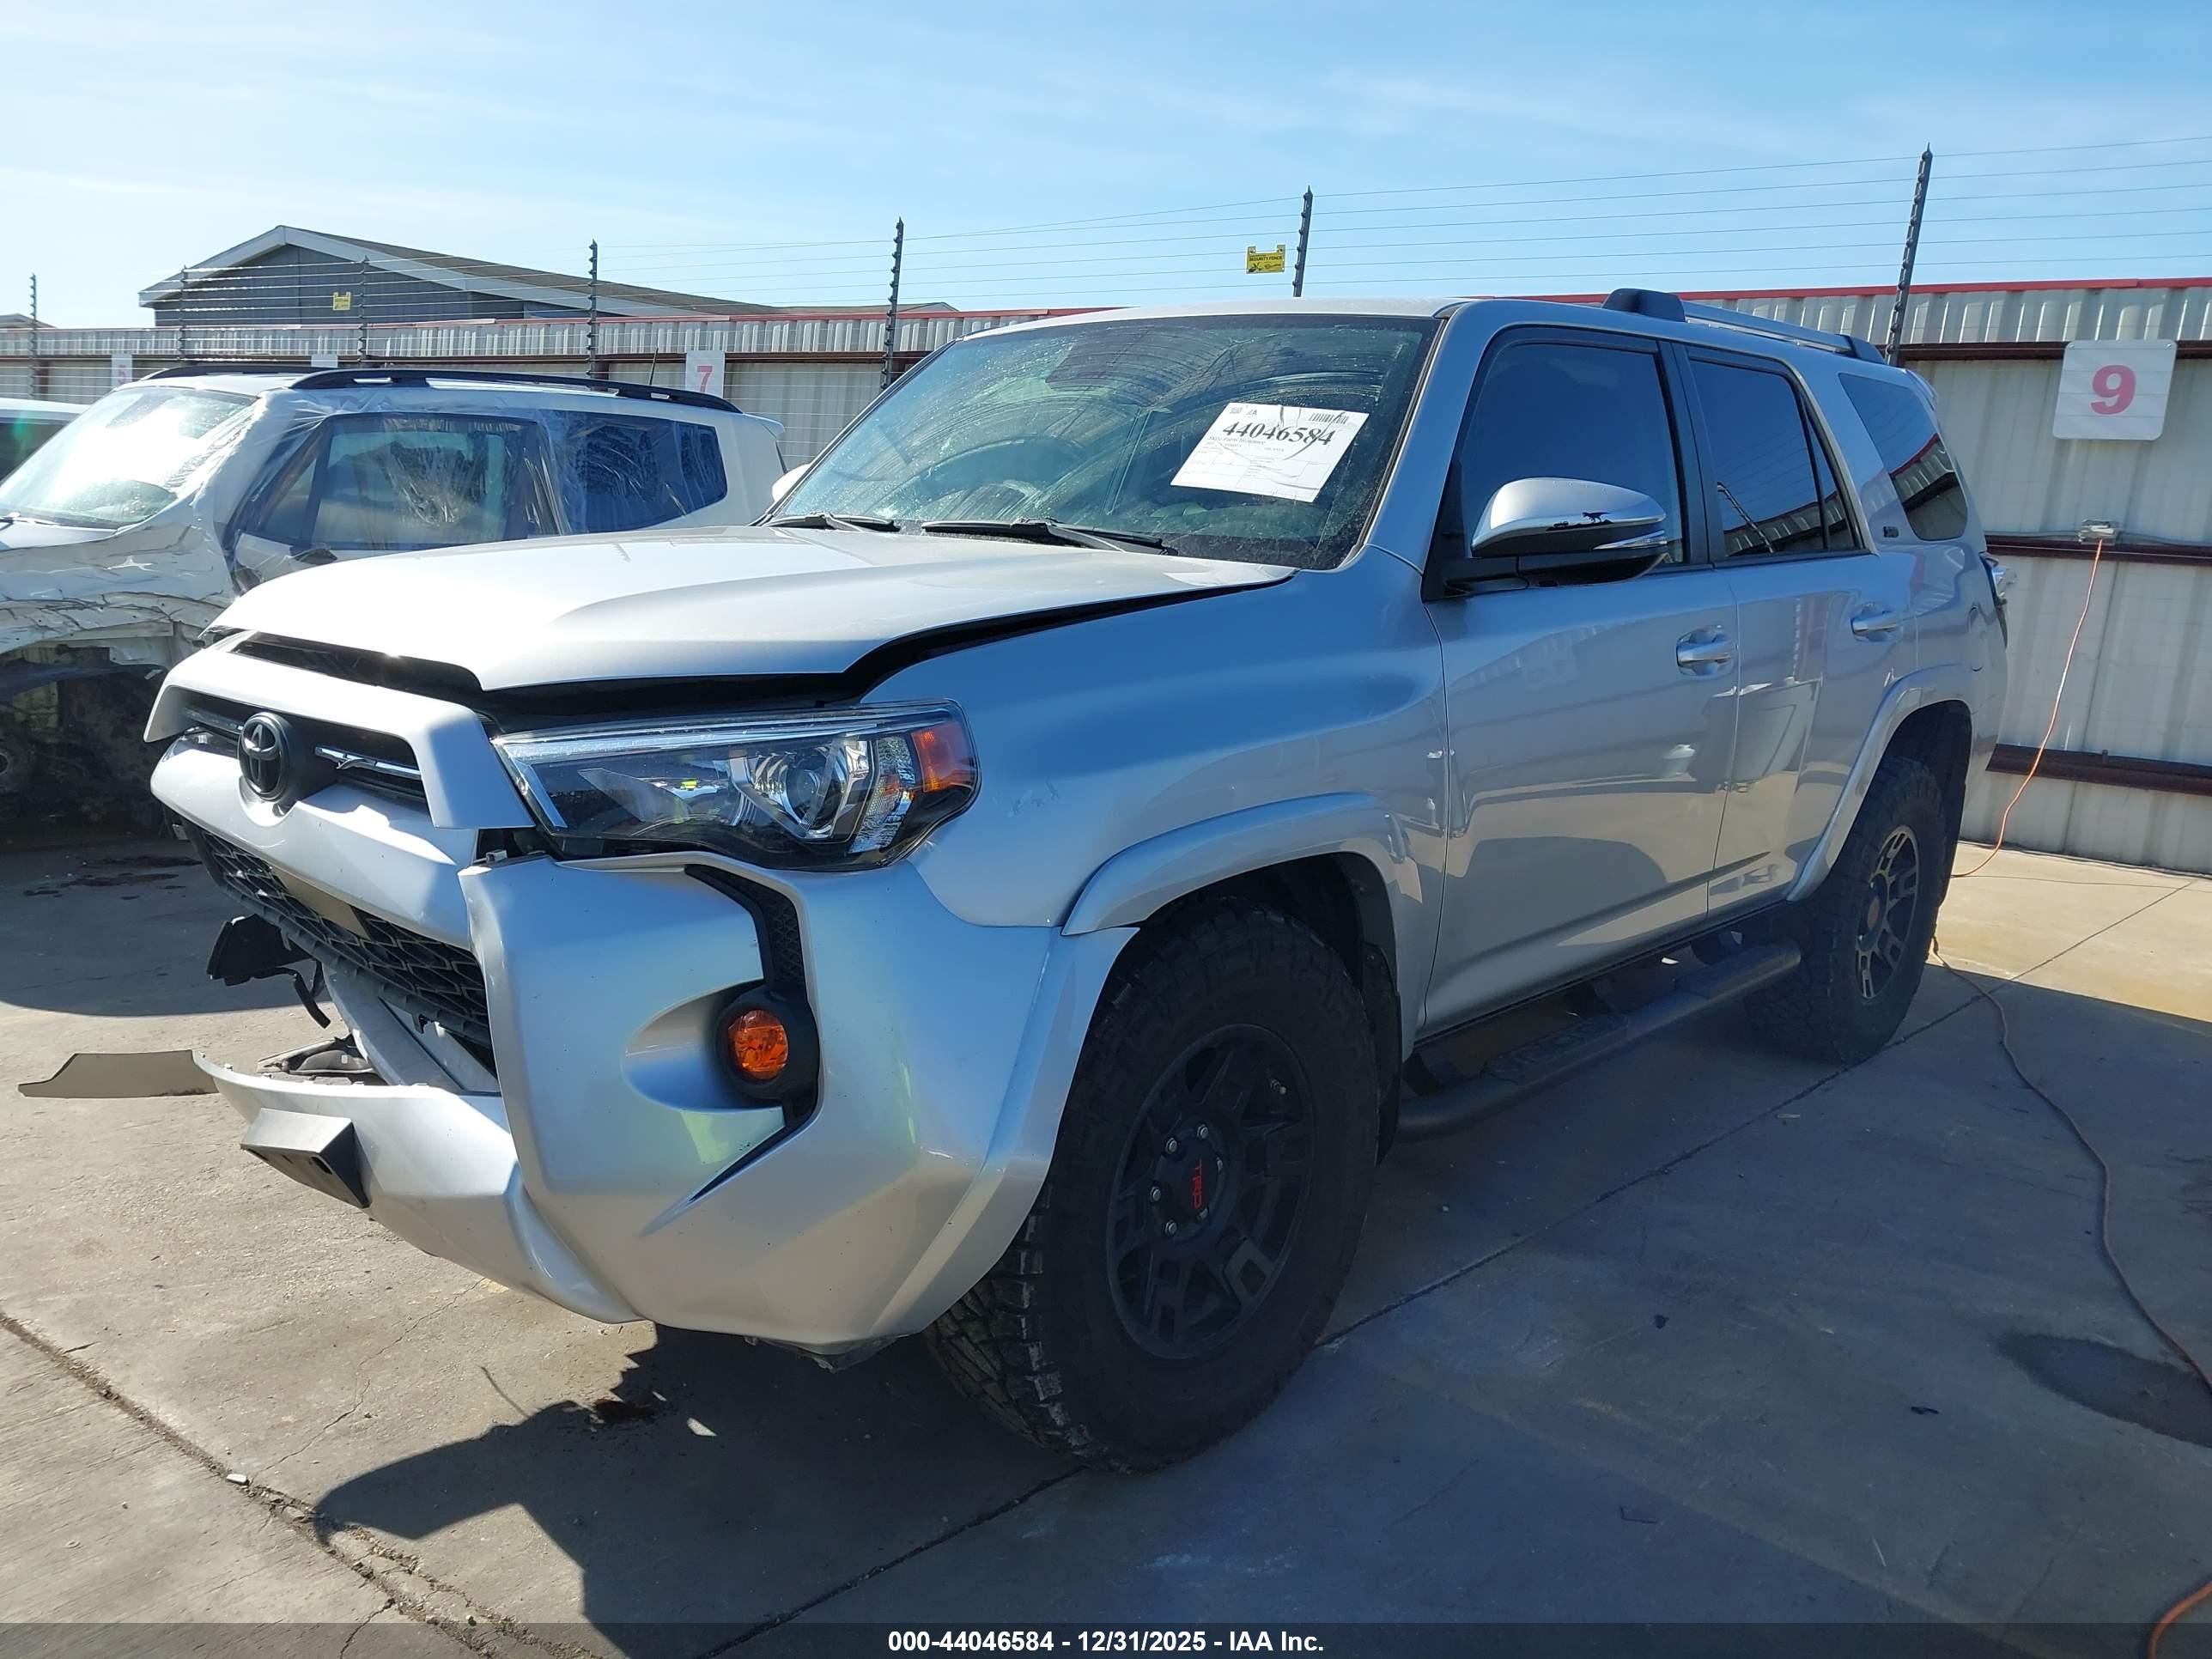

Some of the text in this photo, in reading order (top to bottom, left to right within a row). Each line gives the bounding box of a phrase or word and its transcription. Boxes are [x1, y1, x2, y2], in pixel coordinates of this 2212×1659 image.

[696, 365, 713, 393] 7
[2090, 364, 2136, 415] 9
[1223, 421, 1336, 446] 44046584
